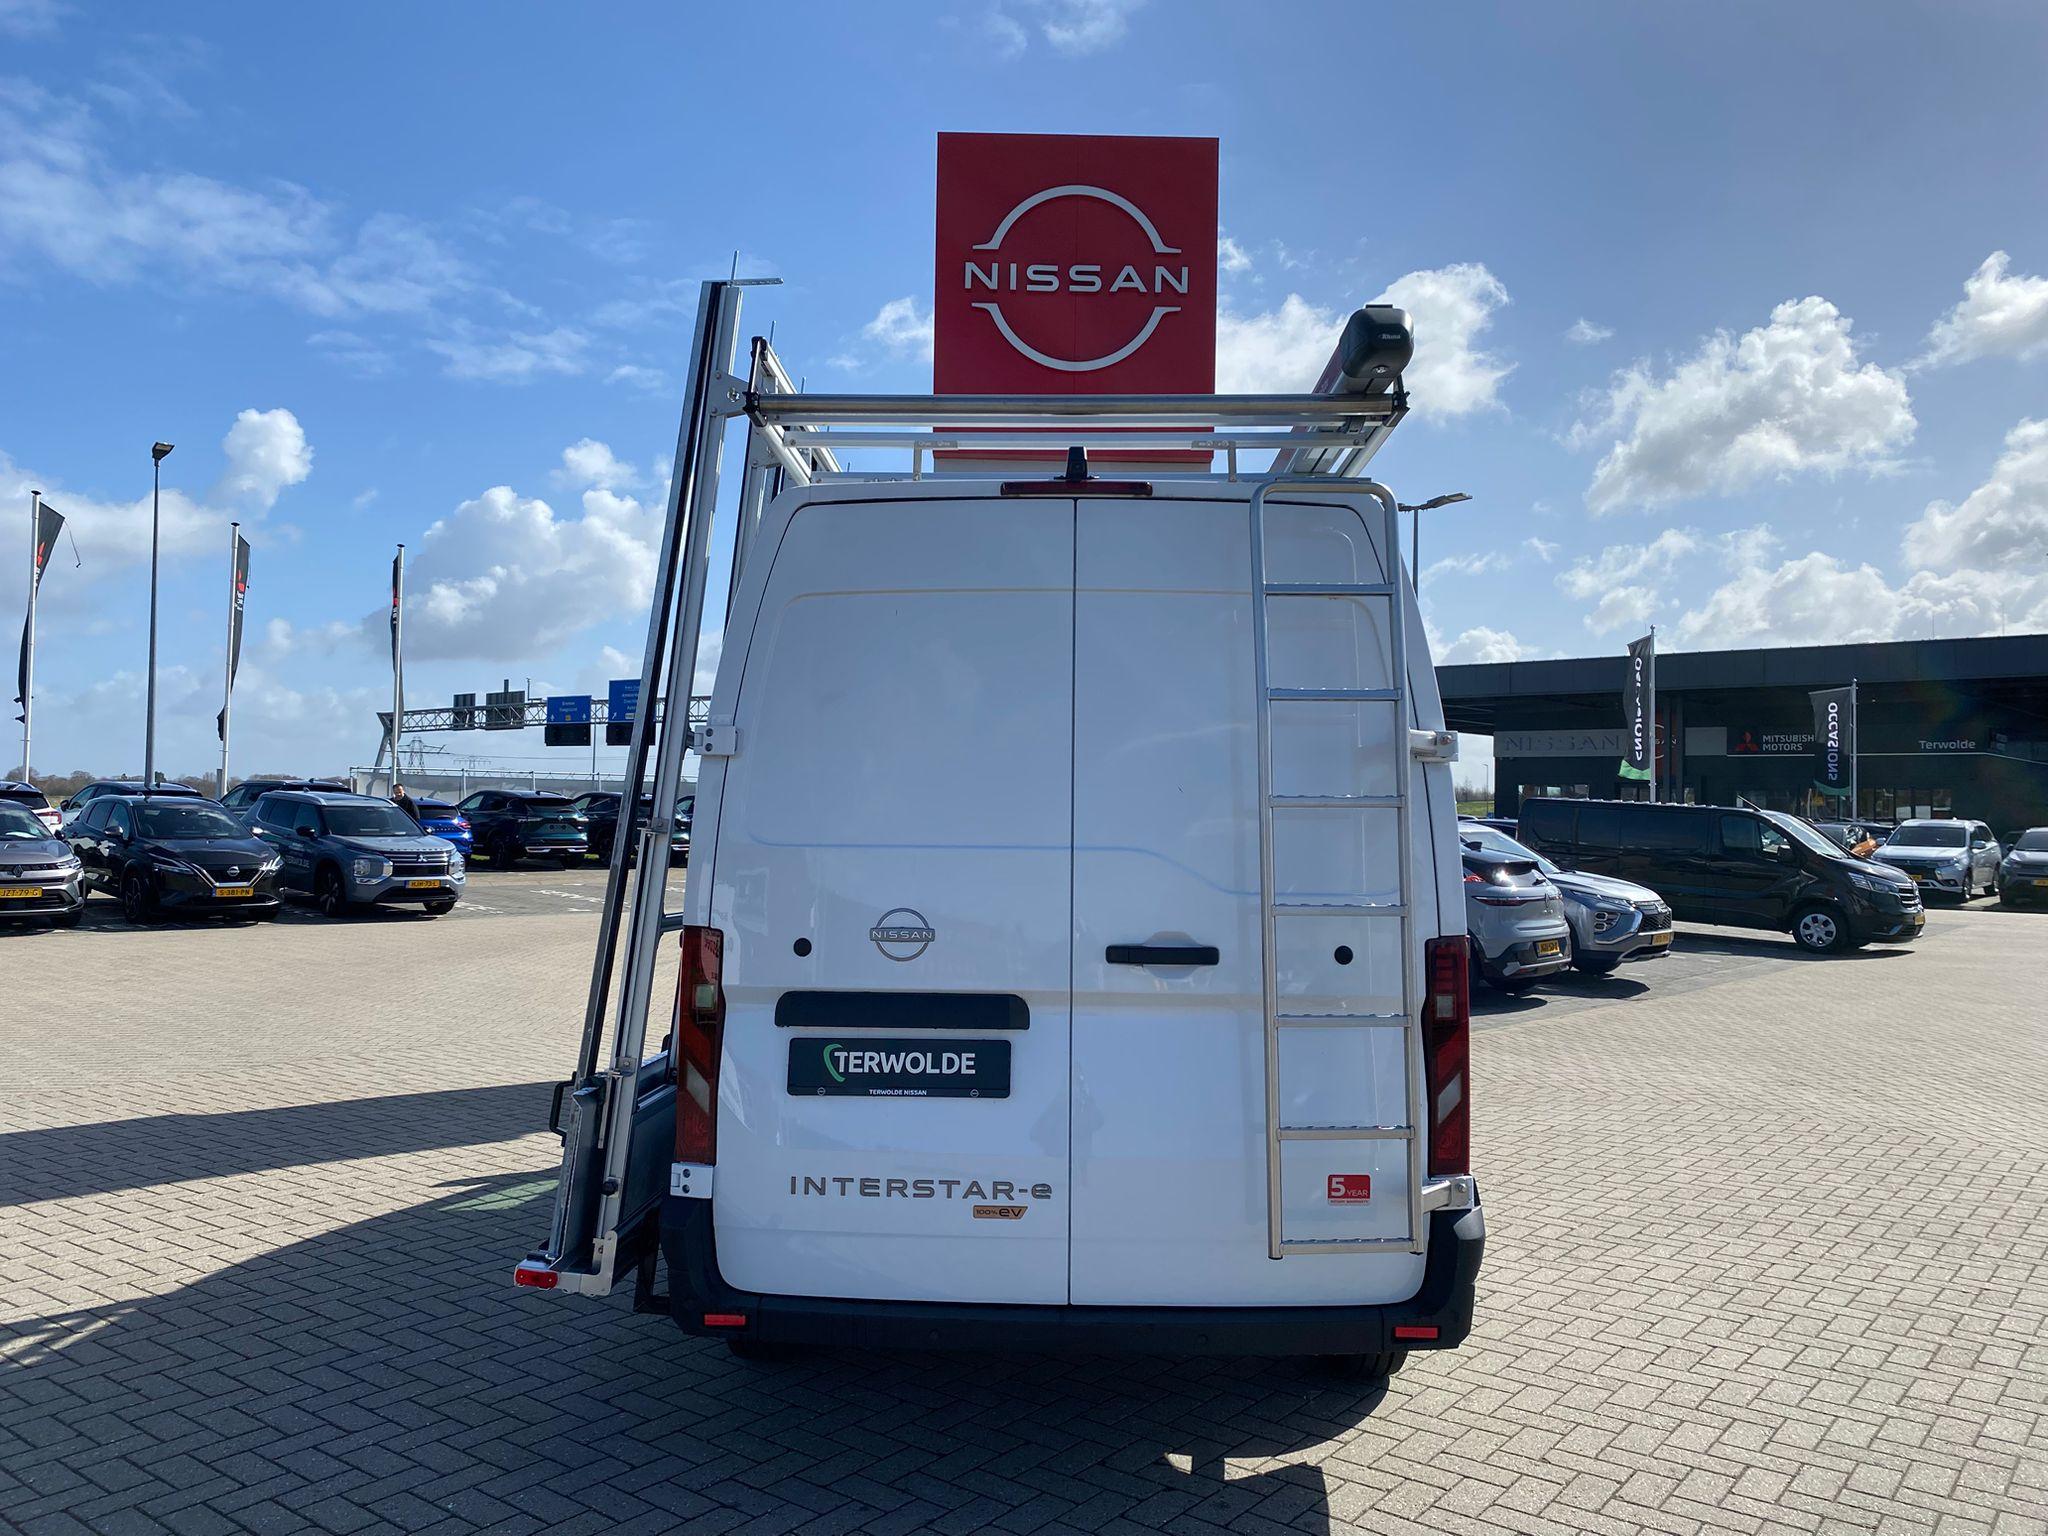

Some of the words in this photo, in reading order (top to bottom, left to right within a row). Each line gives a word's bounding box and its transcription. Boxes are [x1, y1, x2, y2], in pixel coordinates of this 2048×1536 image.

[964, 261, 1189, 294] NISSAN
[1506, 735, 1619, 751] NISSAN
[1762, 734, 1815, 742] MITSUBISH
[1919, 740, 1976, 750] Terwolde
[1762, 743, 1803, 751] MOTORS
[872, 931, 932, 939] NISSAN
[834, 1052, 976, 1074] TERWOLDE
[790, 1176, 1053, 1200] INTERSTAR-e
[1331, 1177, 1346, 1197] 5
[1346, 1189, 1368, 1197] YEAR
